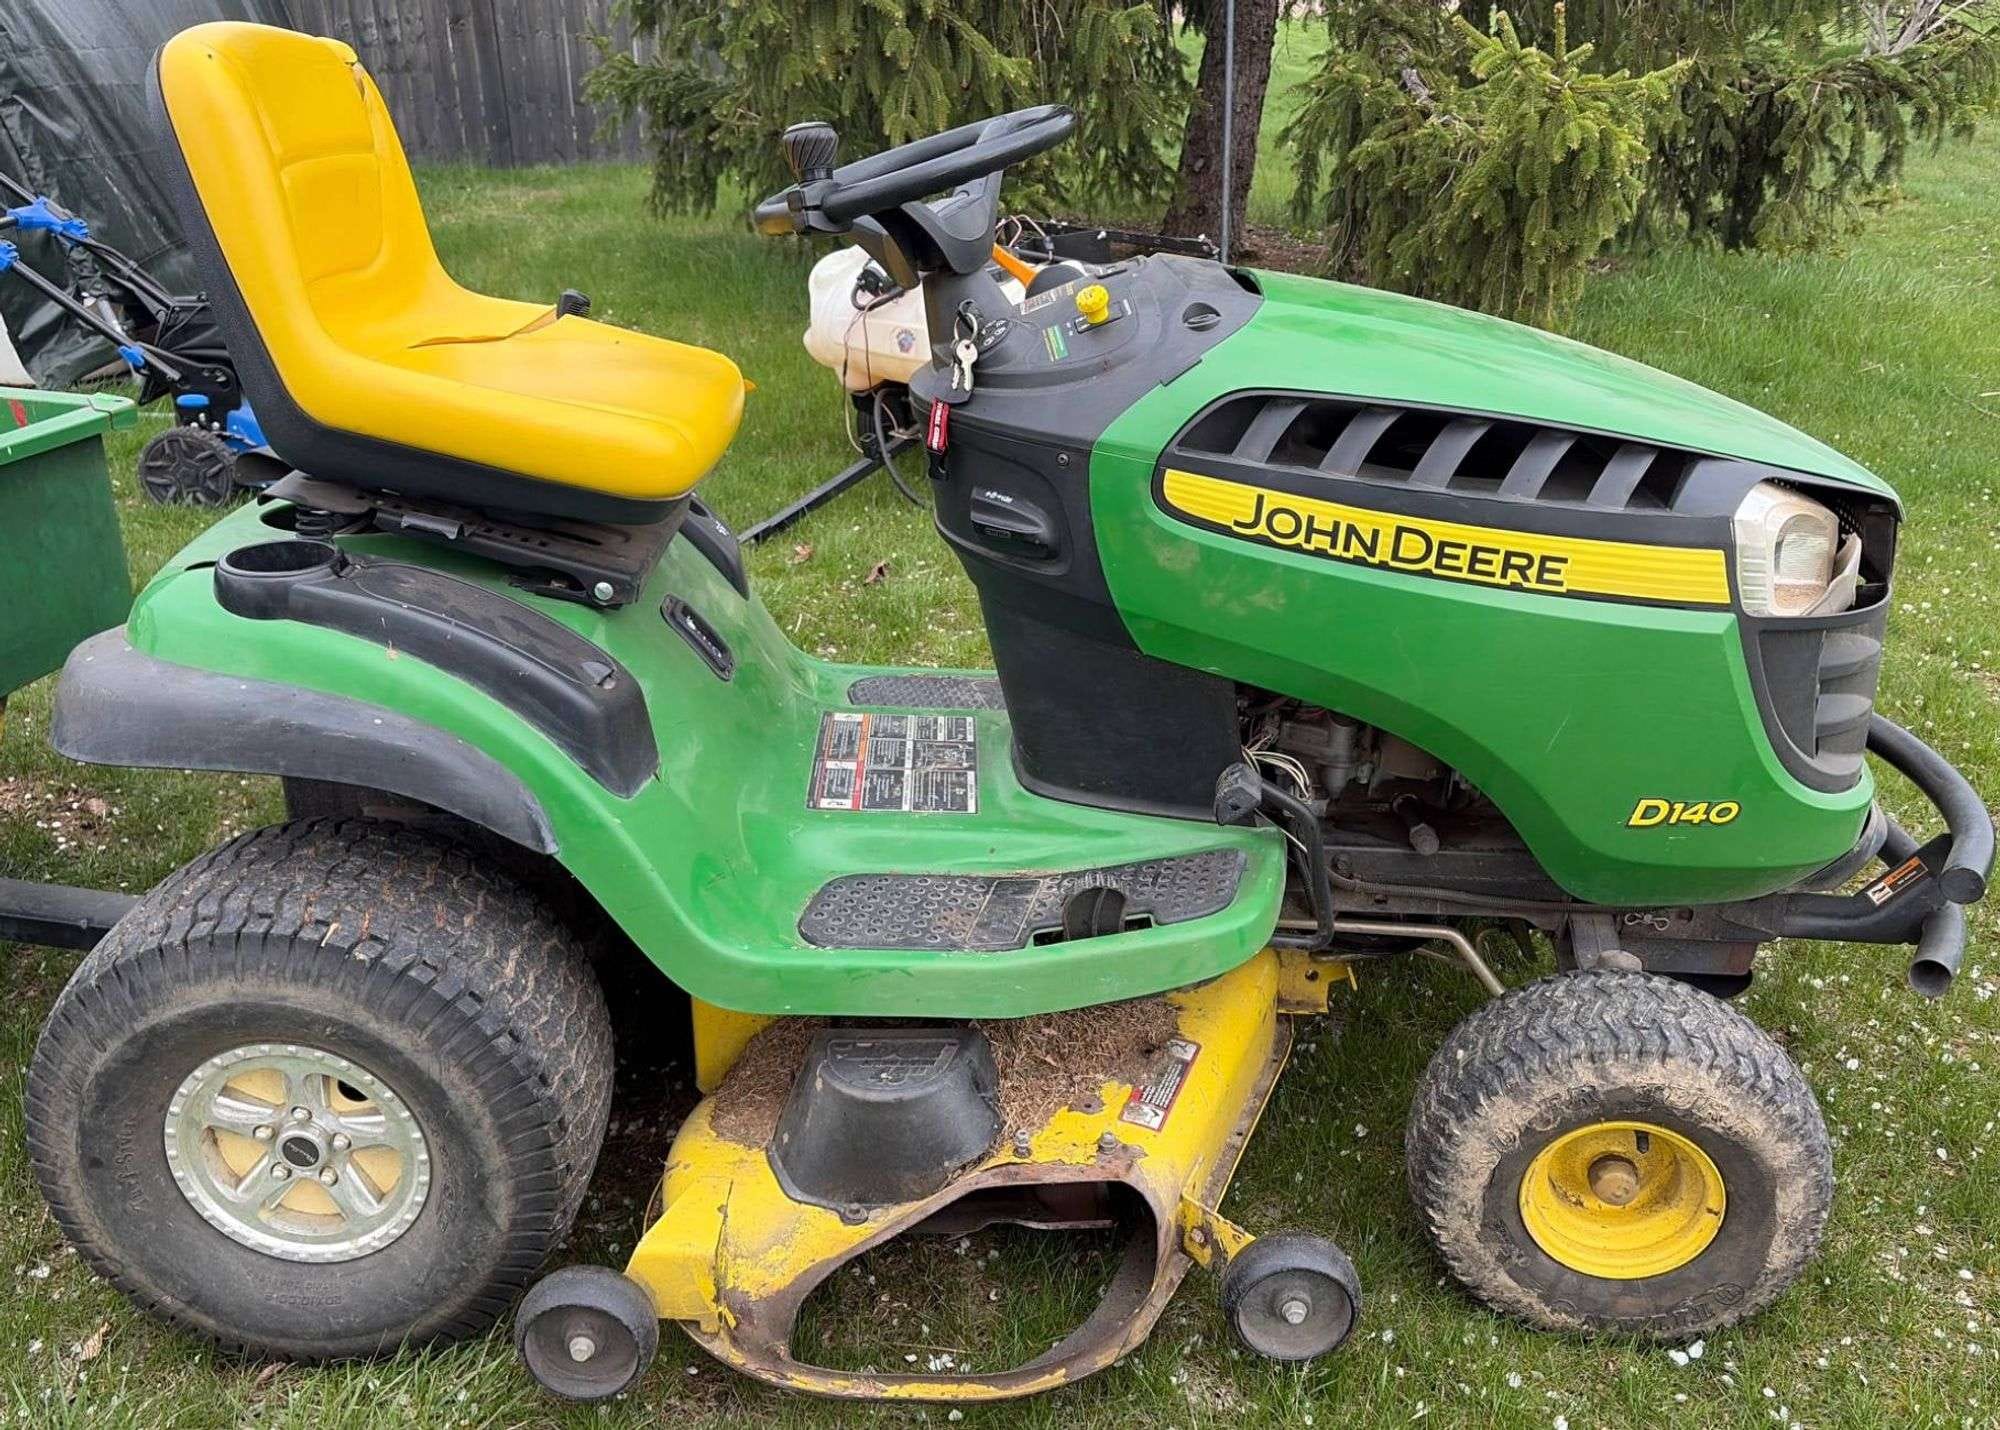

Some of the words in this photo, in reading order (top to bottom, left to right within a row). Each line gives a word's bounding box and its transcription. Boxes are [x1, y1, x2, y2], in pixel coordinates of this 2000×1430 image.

[1233, 494, 1380, 558] JOHN
[1391, 525, 1568, 587] DEERE
[1627, 798, 1740, 826] D140
